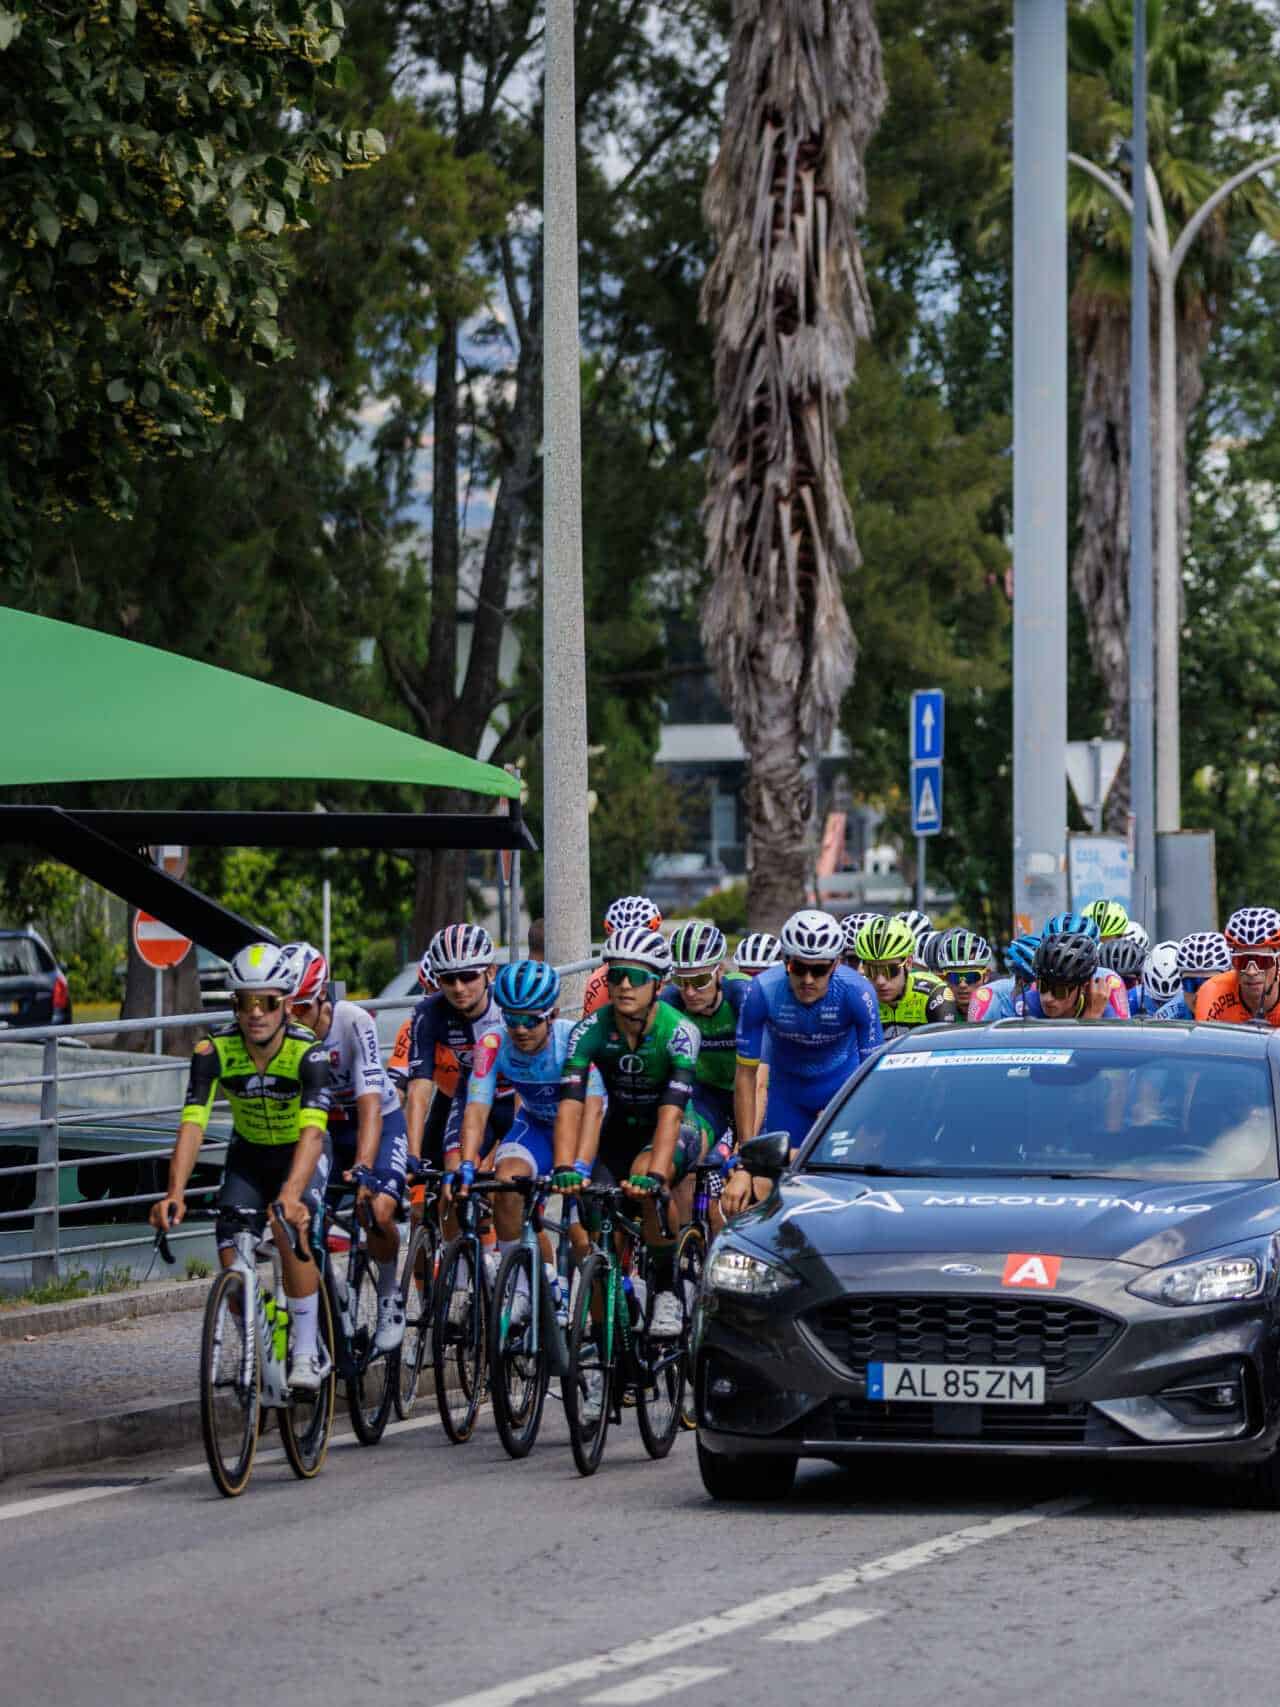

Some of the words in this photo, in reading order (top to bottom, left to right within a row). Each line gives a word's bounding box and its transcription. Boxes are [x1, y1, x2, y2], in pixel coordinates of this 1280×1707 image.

[923, 1196, 1212, 1214] MCOUTINHO
[1010, 1257, 1049, 1285] A
[895, 1368, 937, 1398] AL
[944, 1369, 980, 1398] 85
[985, 1370, 1034, 1400] ZM
